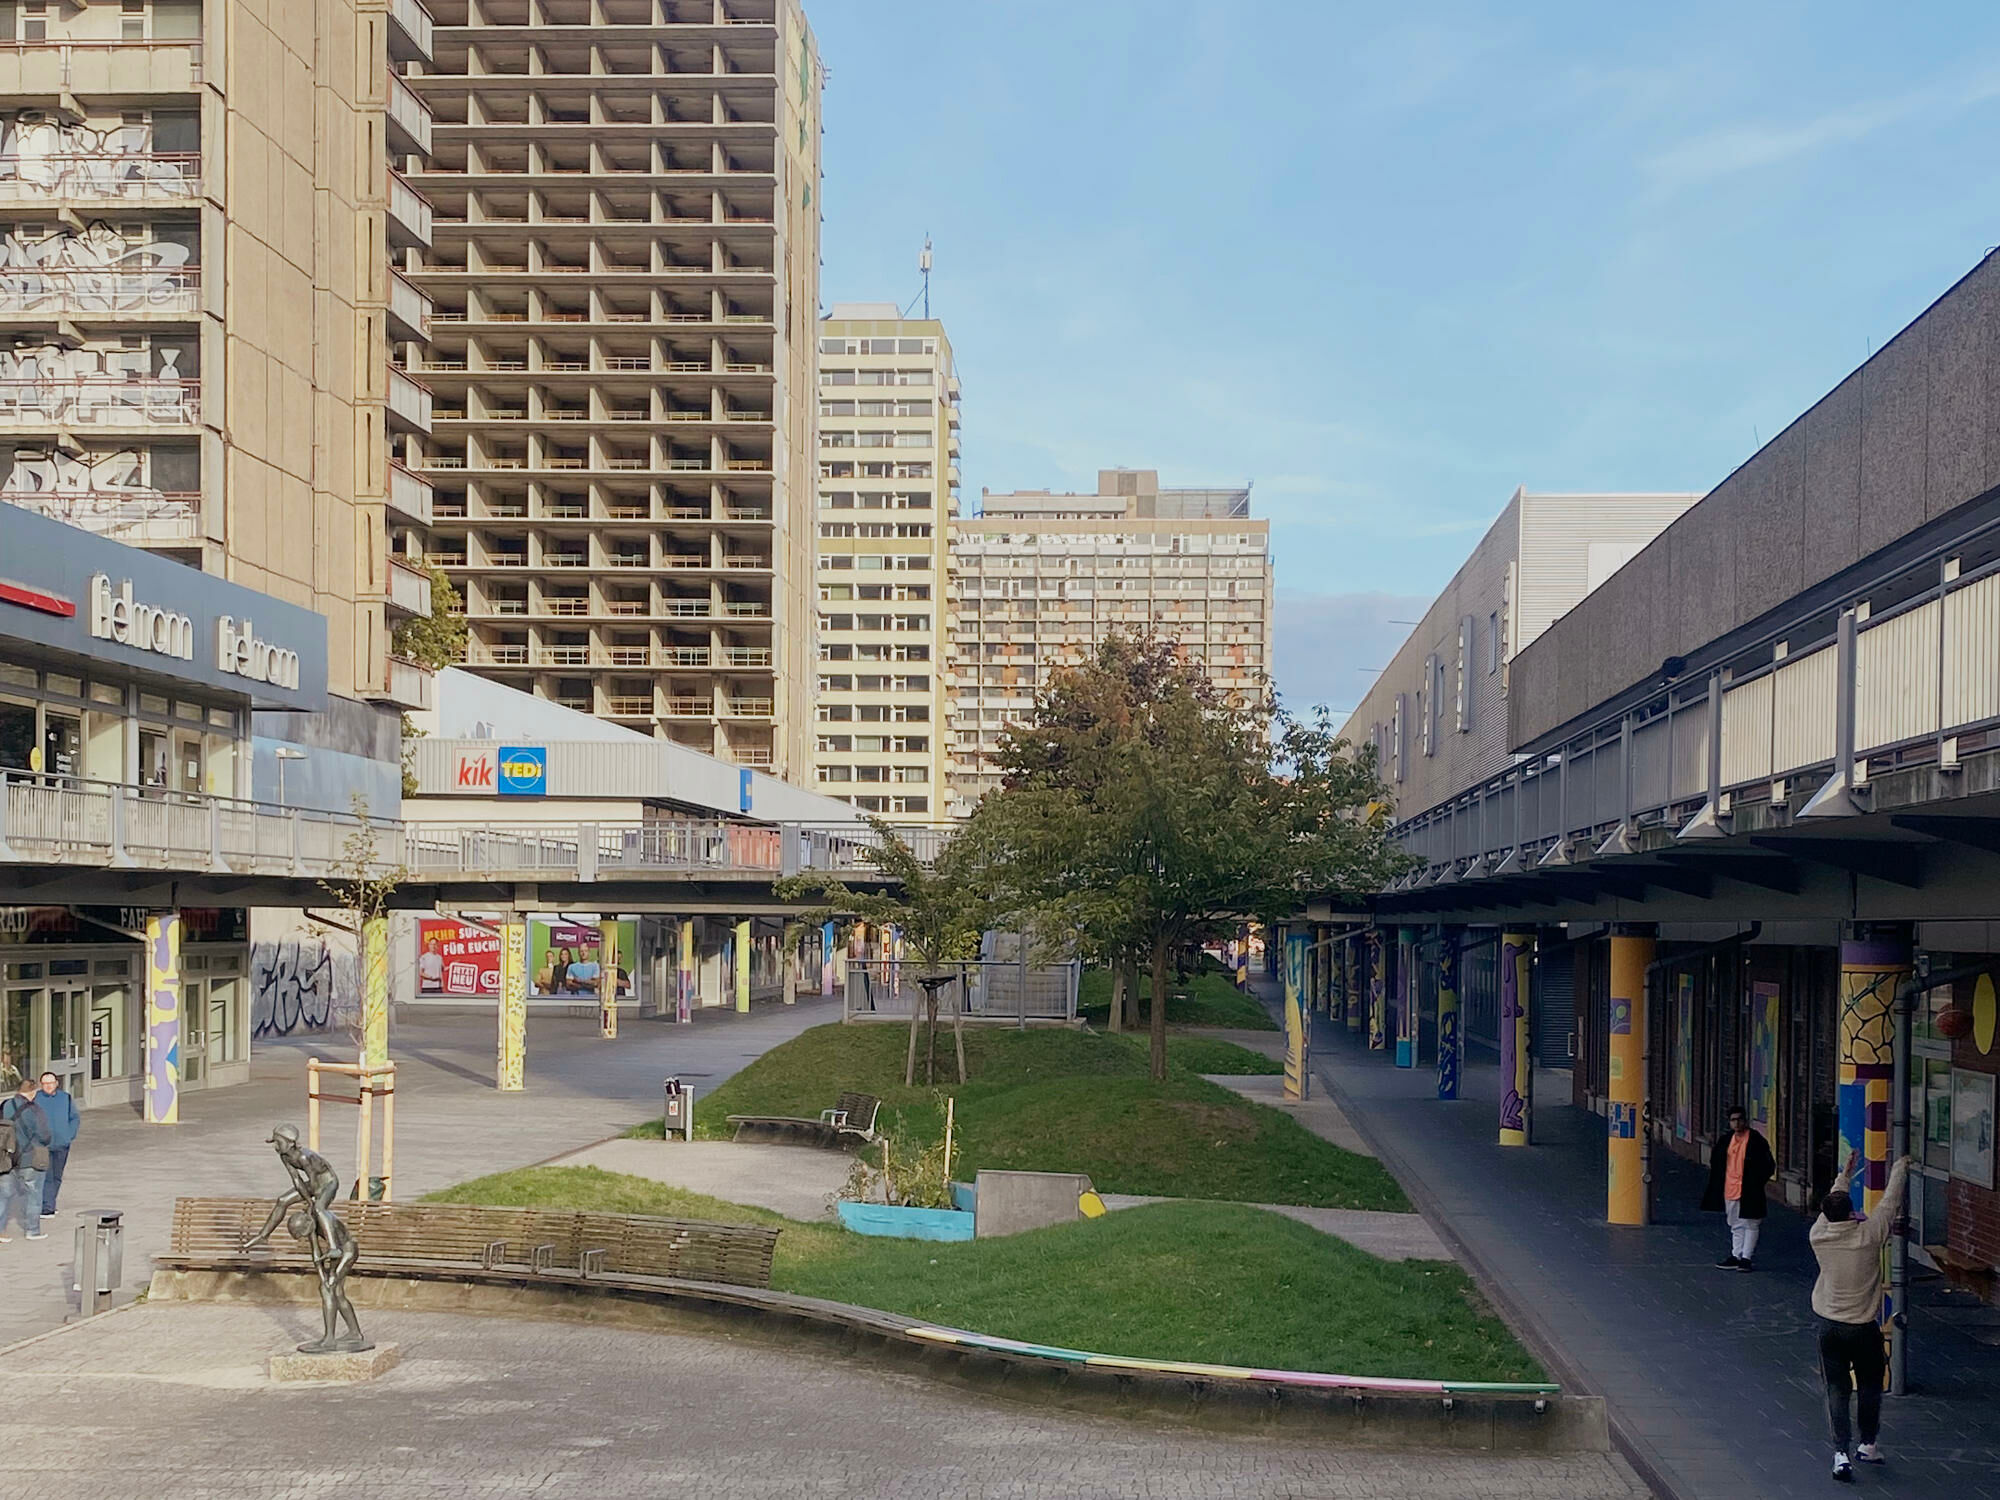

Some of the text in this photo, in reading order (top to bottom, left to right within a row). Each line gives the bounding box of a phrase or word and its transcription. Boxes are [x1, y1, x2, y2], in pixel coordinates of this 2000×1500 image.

[91, 574, 193, 660] fielmann
[218, 616, 299, 690] fielmann
[502, 762, 542, 778] TEDi
[120, 908, 148, 931] FAH
[443, 942, 465, 956] FÜR
[452, 975, 474, 985] NEU
